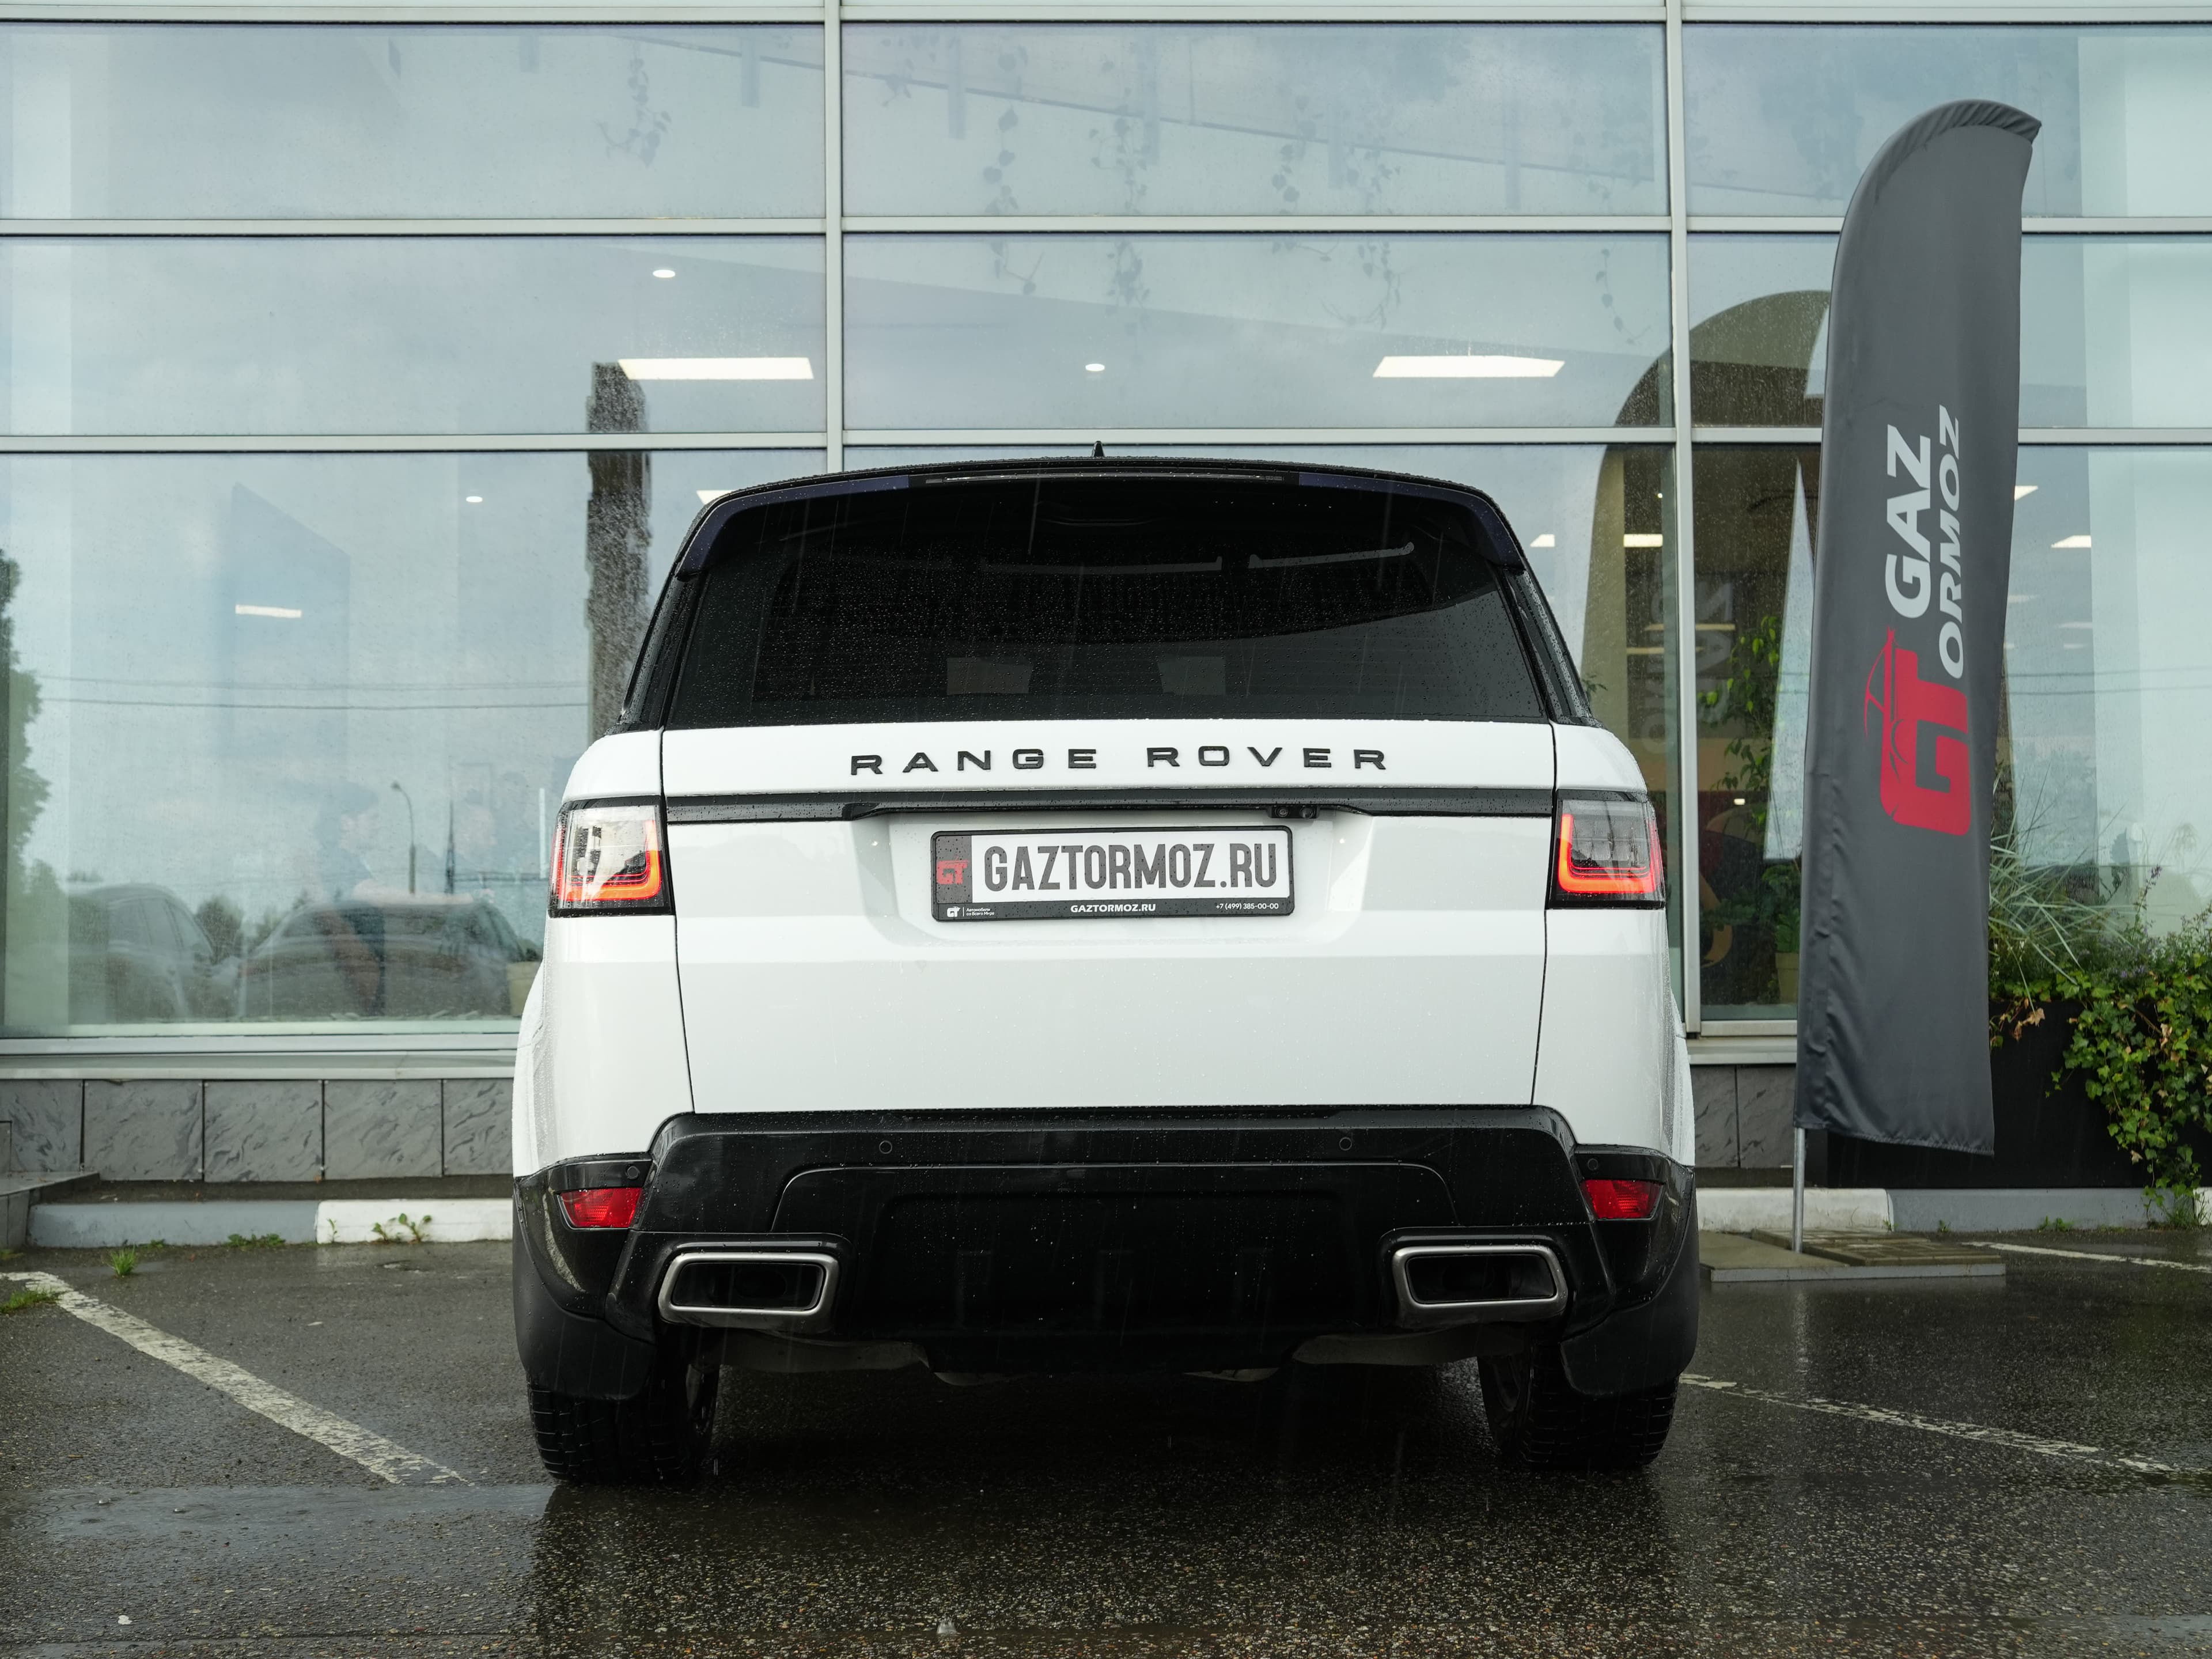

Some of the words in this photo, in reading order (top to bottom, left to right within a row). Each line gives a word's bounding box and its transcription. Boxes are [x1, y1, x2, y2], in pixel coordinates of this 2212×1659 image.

[1885, 423, 1931, 619] GAZ
[1938, 404, 1964, 679] ORMOZ
[1880, 631, 1971, 836] GT
[851, 748, 1097, 775] RANGE
[1146, 745, 1386, 770] ROVER
[936, 859, 969, 885] GT
[984, 843, 1277, 892] GAZTORMOZ.RU
[1070, 903, 1156, 912] GAZTORMOZ.RU
